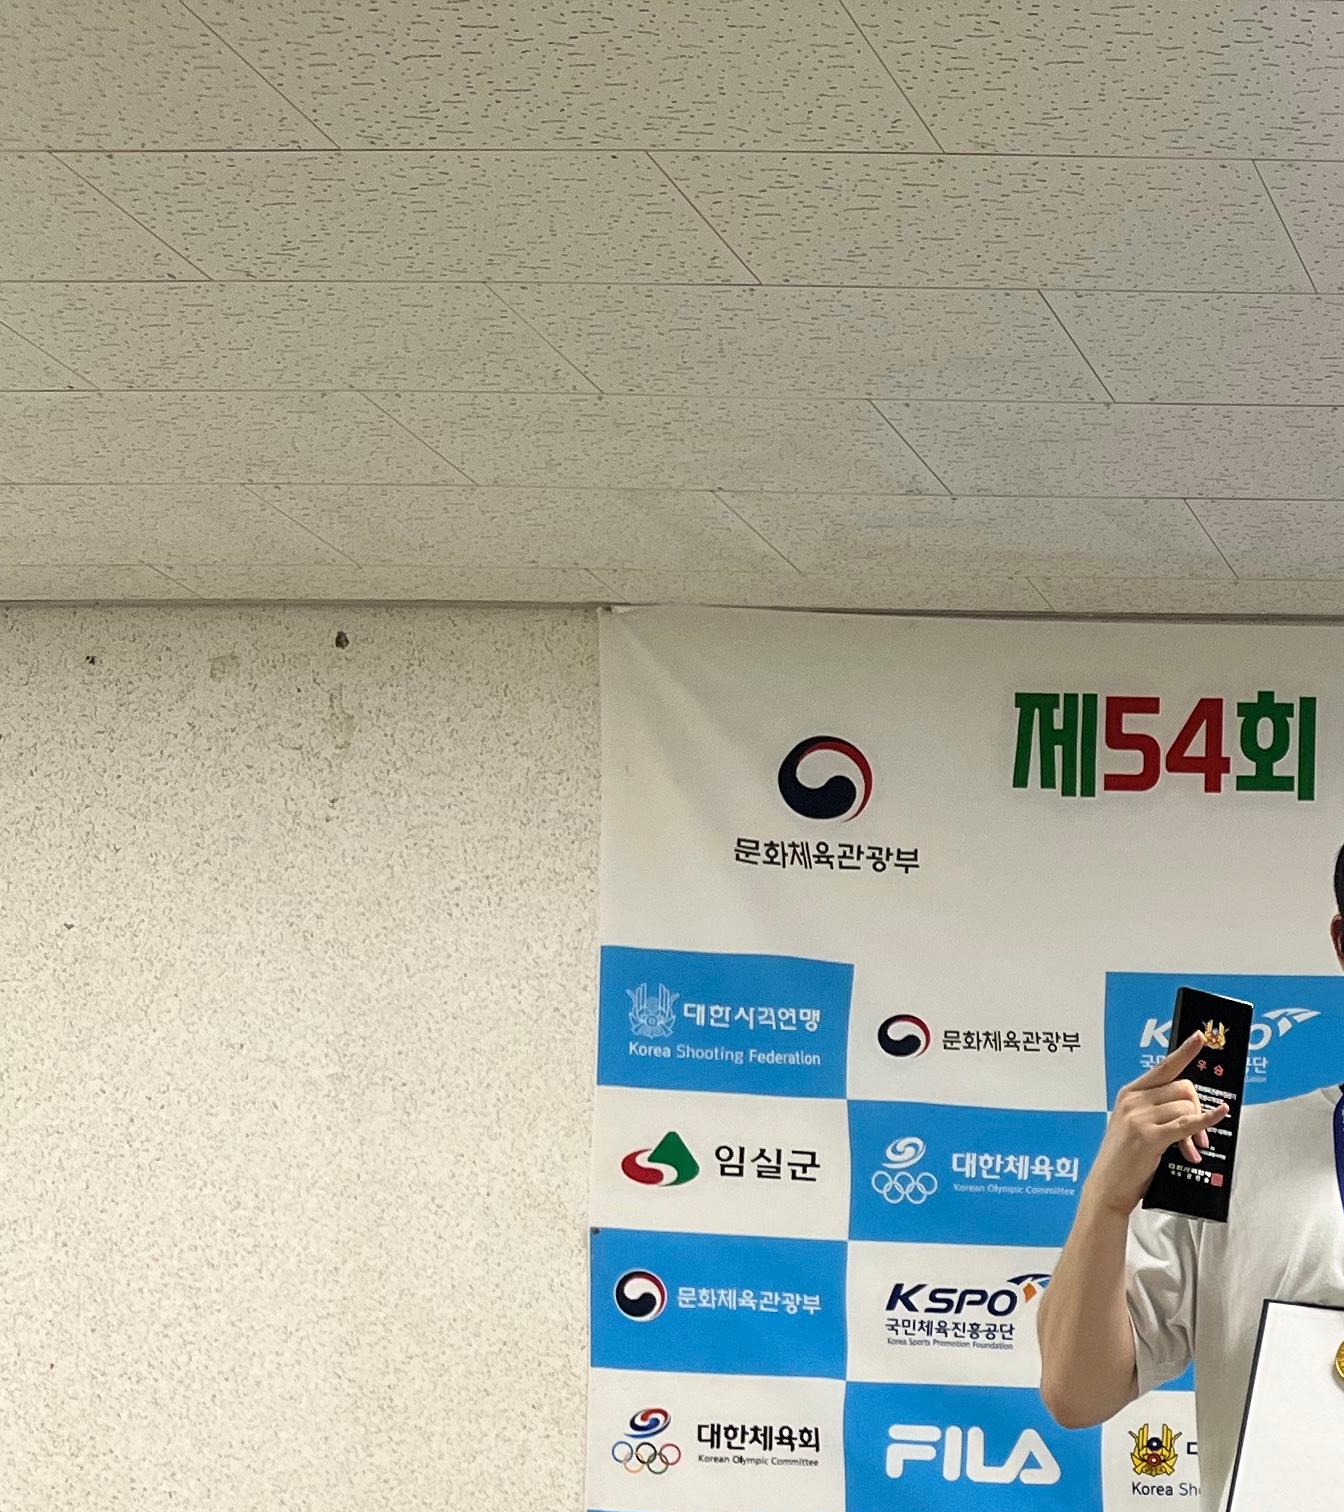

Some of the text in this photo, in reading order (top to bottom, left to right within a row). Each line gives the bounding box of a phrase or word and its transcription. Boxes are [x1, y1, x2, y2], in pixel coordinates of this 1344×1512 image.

[1012, 691, 1317, 801] 제54회
[733, 838, 920, 874] 문화체육관광부
[683, 1003, 821, 1032] 대한사격연맹
[942, 1029, 1081, 1053] 문화체육관광부
[1139, 1018, 1273, 1050] KO
[629, 1041, 821, 1066] Korea Shooting Federation
[715, 1144, 821, 1182] 임실군
[952, 1153, 1079, 1182] 대한체육회
[953, 1183, 1075, 1196] Korean Olympic Committee
[677, 1287, 822, 1315] 문화체육관광부
[886, 1284, 1018, 1318] KSPO
[885, 1318, 1015, 1340] 국민체육진흥공단
[887, 1337, 1014, 1350] Korea Sports Promotion Foundation
[697, 1424, 820, 1453] 대한체육회
[698, 1454, 819, 1467] Korean Olympic Committee
[885, 1424, 1062, 1485] FILA
[1132, 1482, 1173, 1496] Korea
